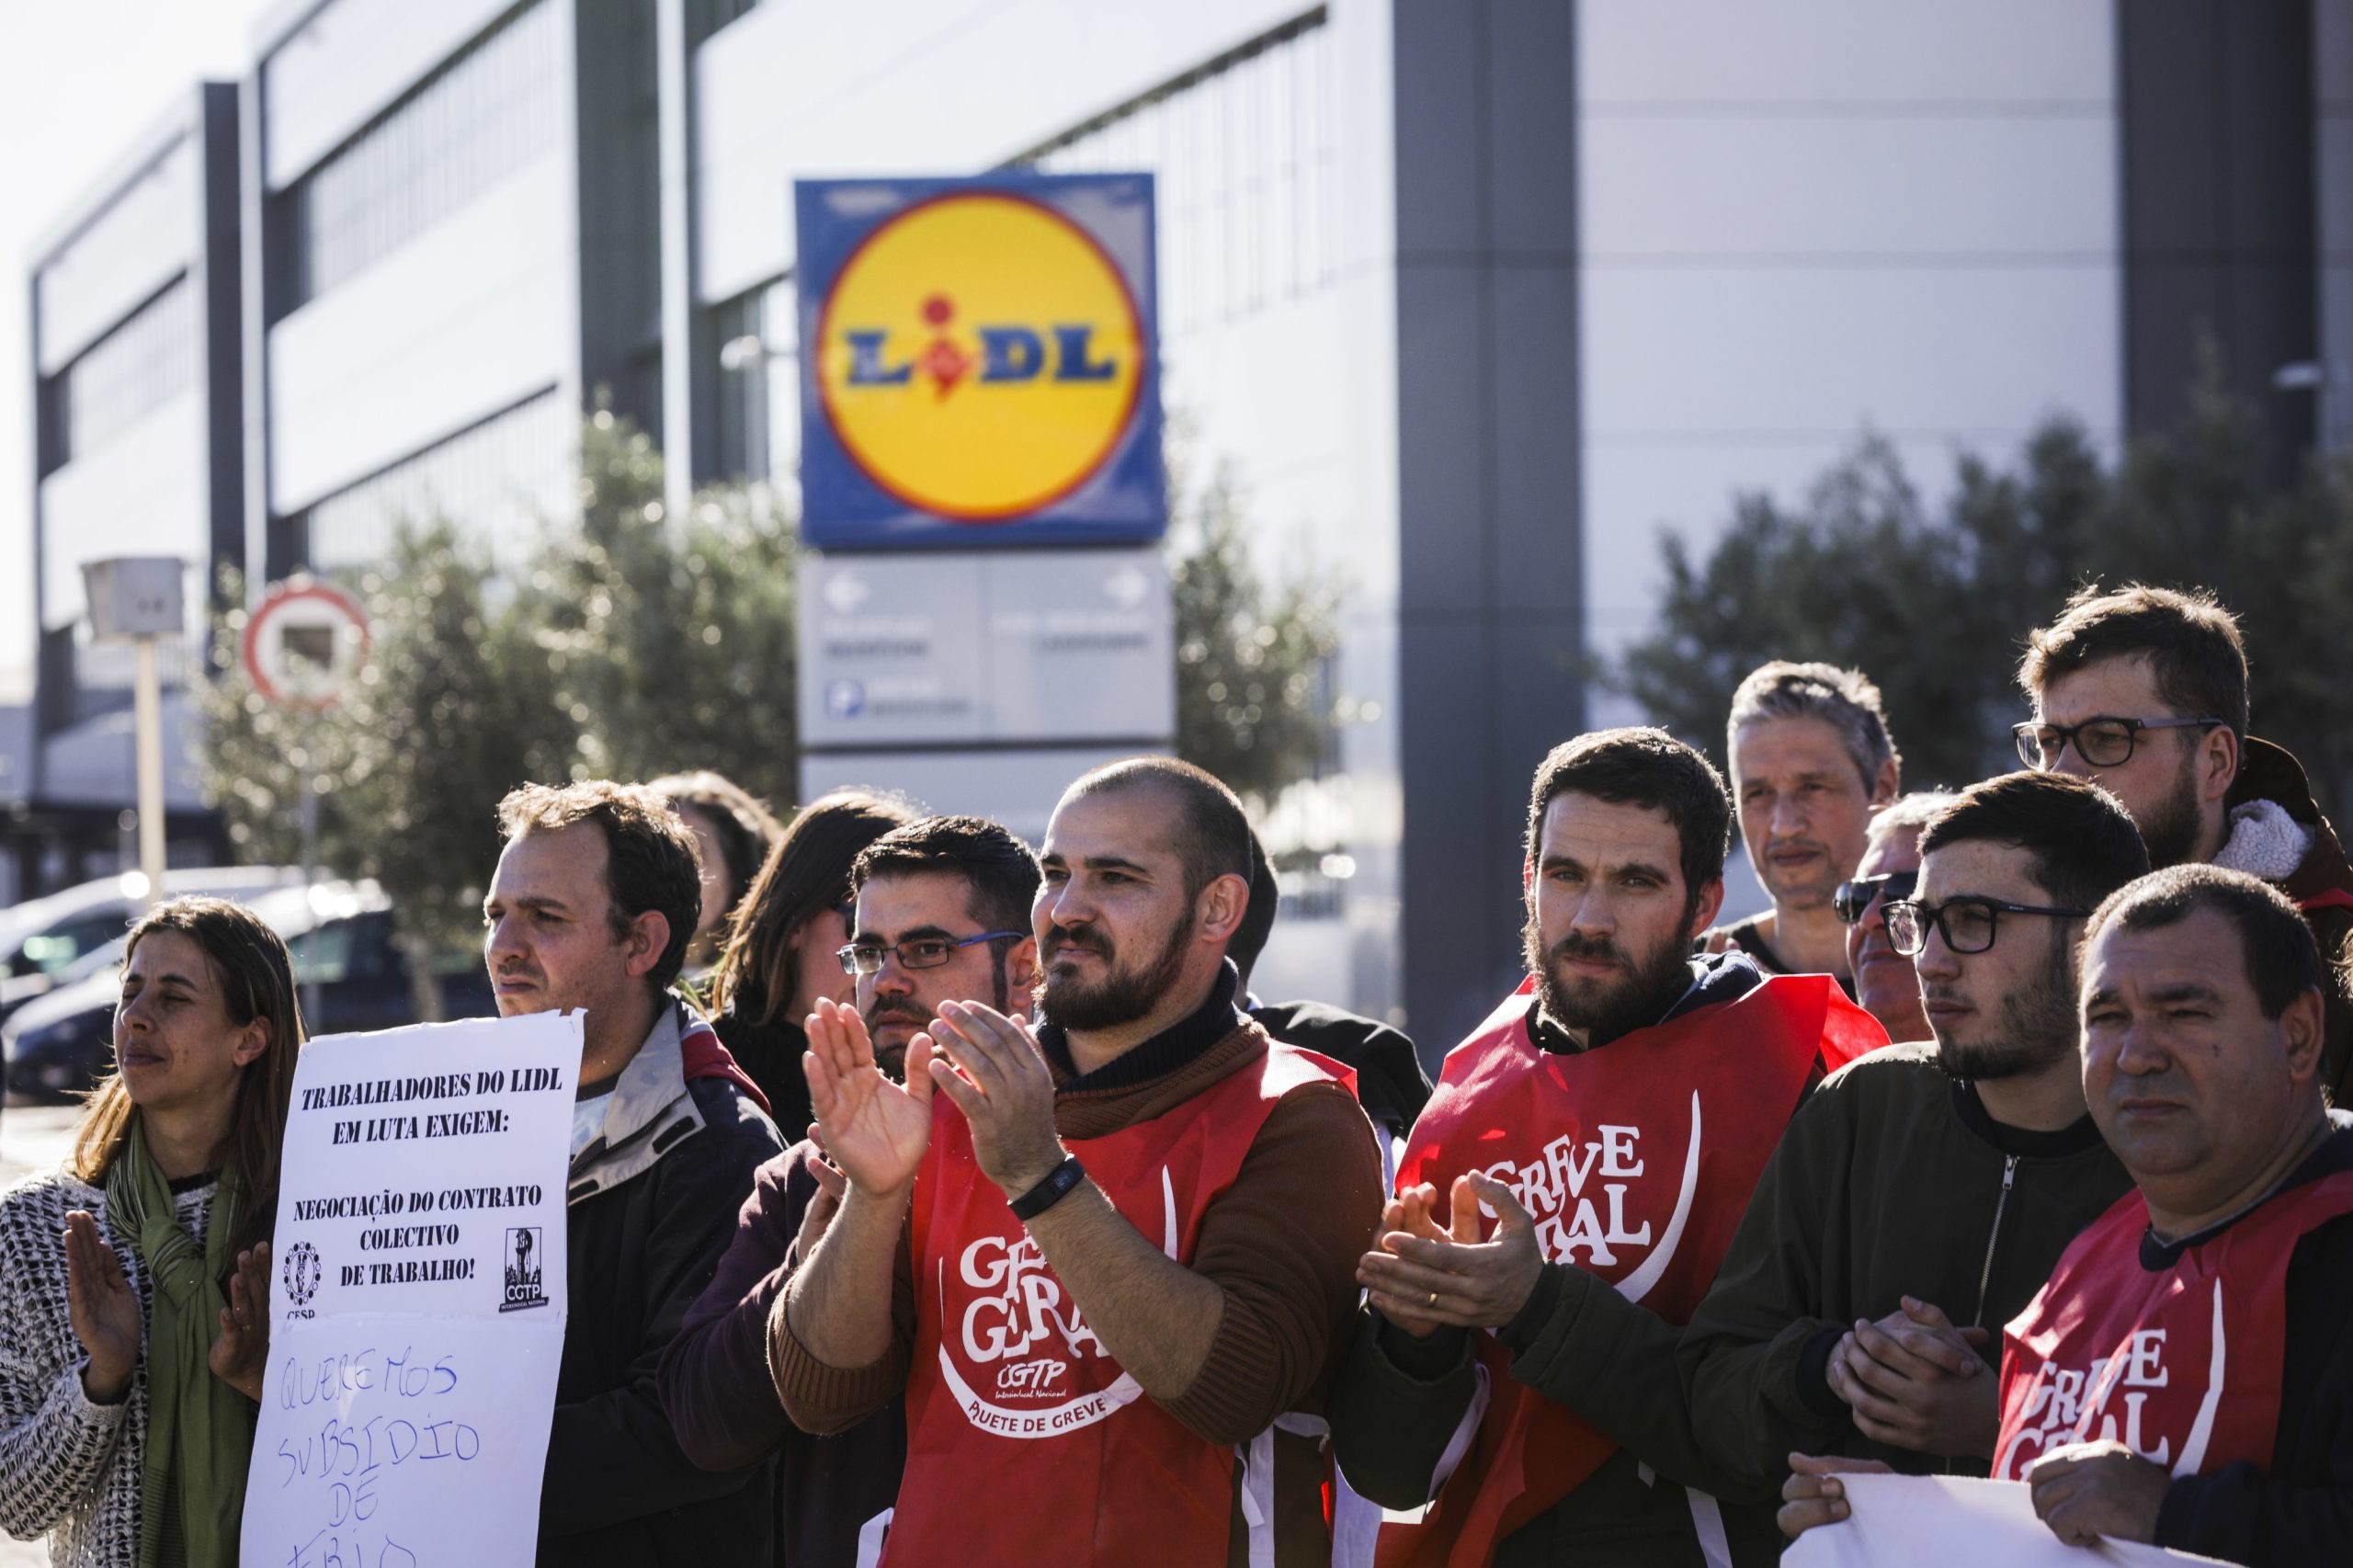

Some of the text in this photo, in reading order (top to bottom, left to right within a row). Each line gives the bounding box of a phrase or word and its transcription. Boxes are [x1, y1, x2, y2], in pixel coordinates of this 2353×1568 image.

[301, 1067, 563, 1110] TRABALHADORES DO LIDL
[333, 1109, 509, 1144] EM LUTA EXIGEM:
[293, 1185, 542, 1222] NEGOCIAÇÃO DO CONTRATO
[359, 1224, 460, 1251] COLECTIVO
[340, 1258, 475, 1287] DE TRABALHO!
[506, 1284, 540, 1301] CGTP
[281, 1346, 458, 1410] QUEREMOS
[997, 1358, 1066, 1389] CGTP
[1023, 1417, 1046, 1432] DE
[1051, 1398, 1107, 1428] GREVE
[328, 1475, 380, 1527] DE
